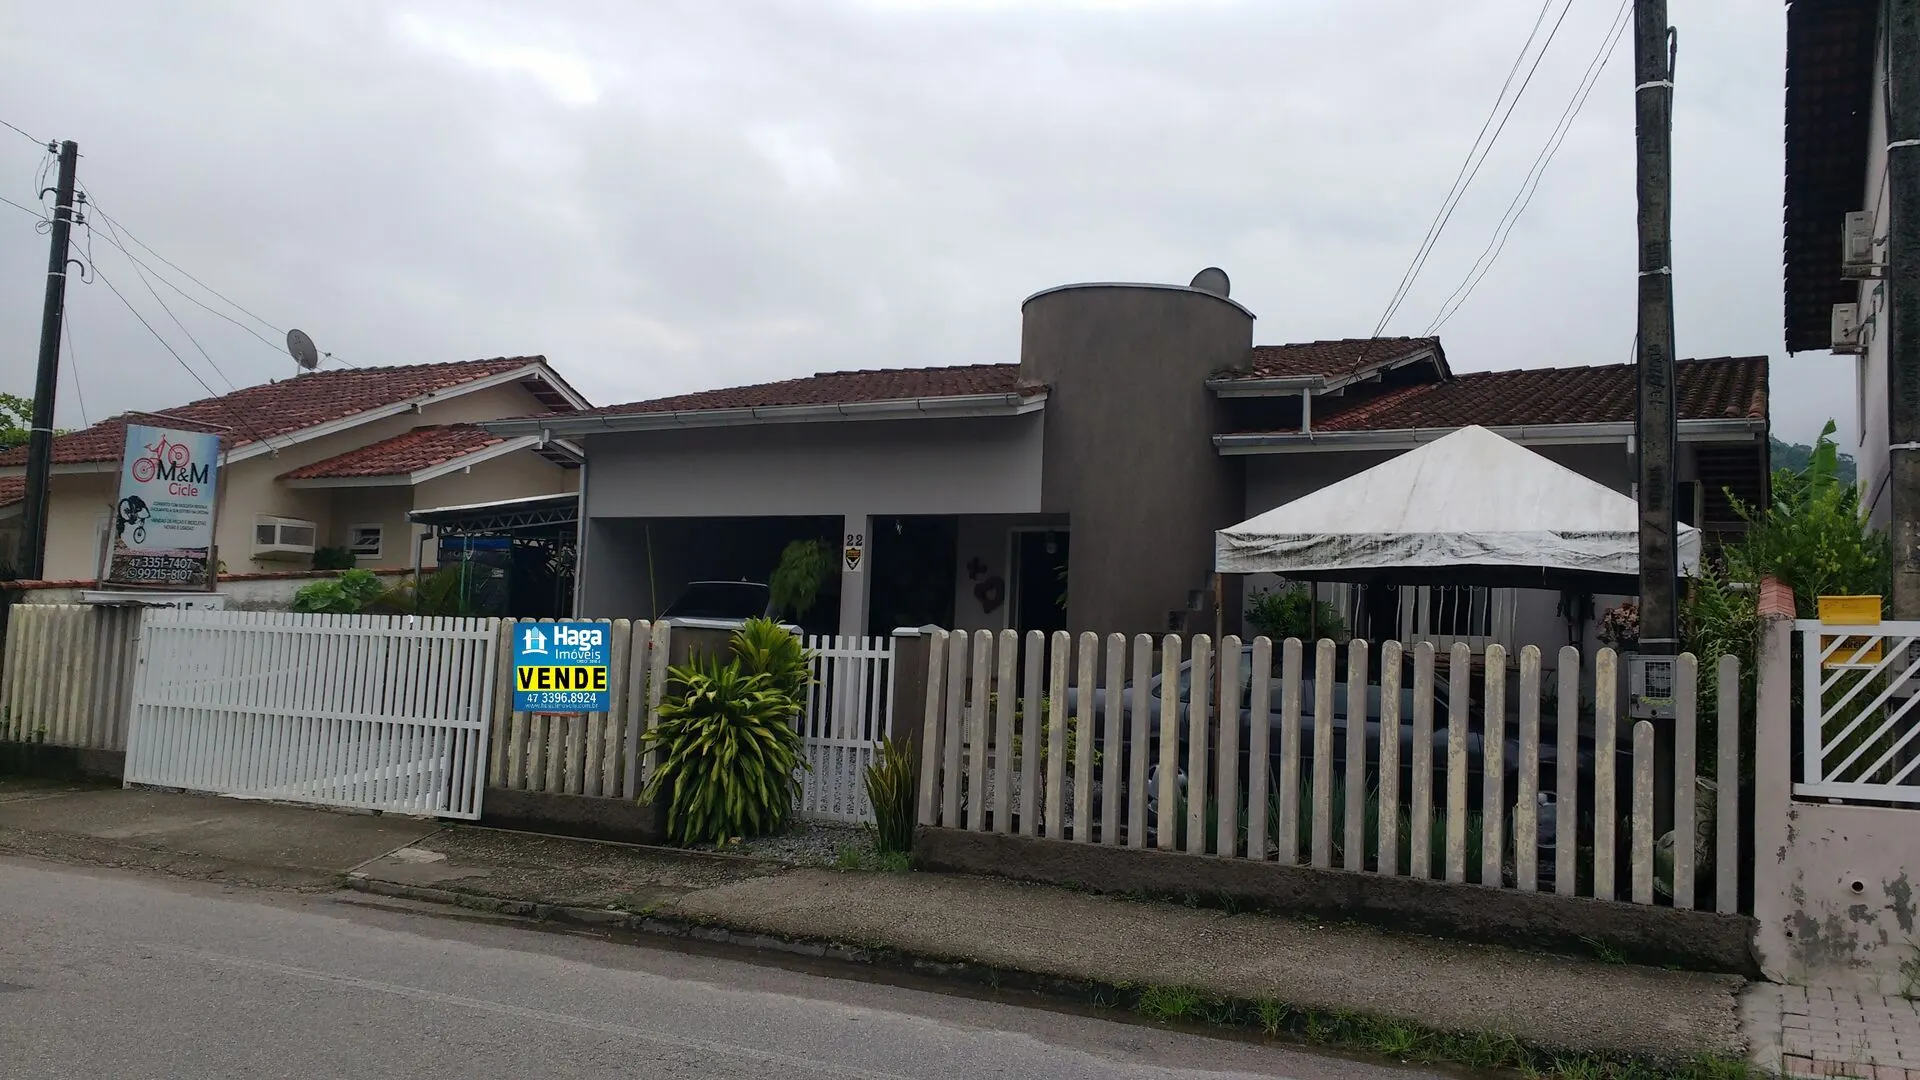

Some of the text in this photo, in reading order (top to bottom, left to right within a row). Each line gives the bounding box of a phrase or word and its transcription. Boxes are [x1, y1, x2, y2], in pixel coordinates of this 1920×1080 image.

[156, 459, 209, 484] M&M
[168, 482, 199, 497] Cicle
[846, 534, 863, 546] 22
[129, 556, 193, 569] 47 3351-7407
[137, 568, 193, 580] 99215-8107
[553, 625, 602, 651] Haga
[555, 649, 601, 660] Imóveis
[518, 666, 606, 690] VENDE
[527, 692, 597, 703] 47 3396.8924
